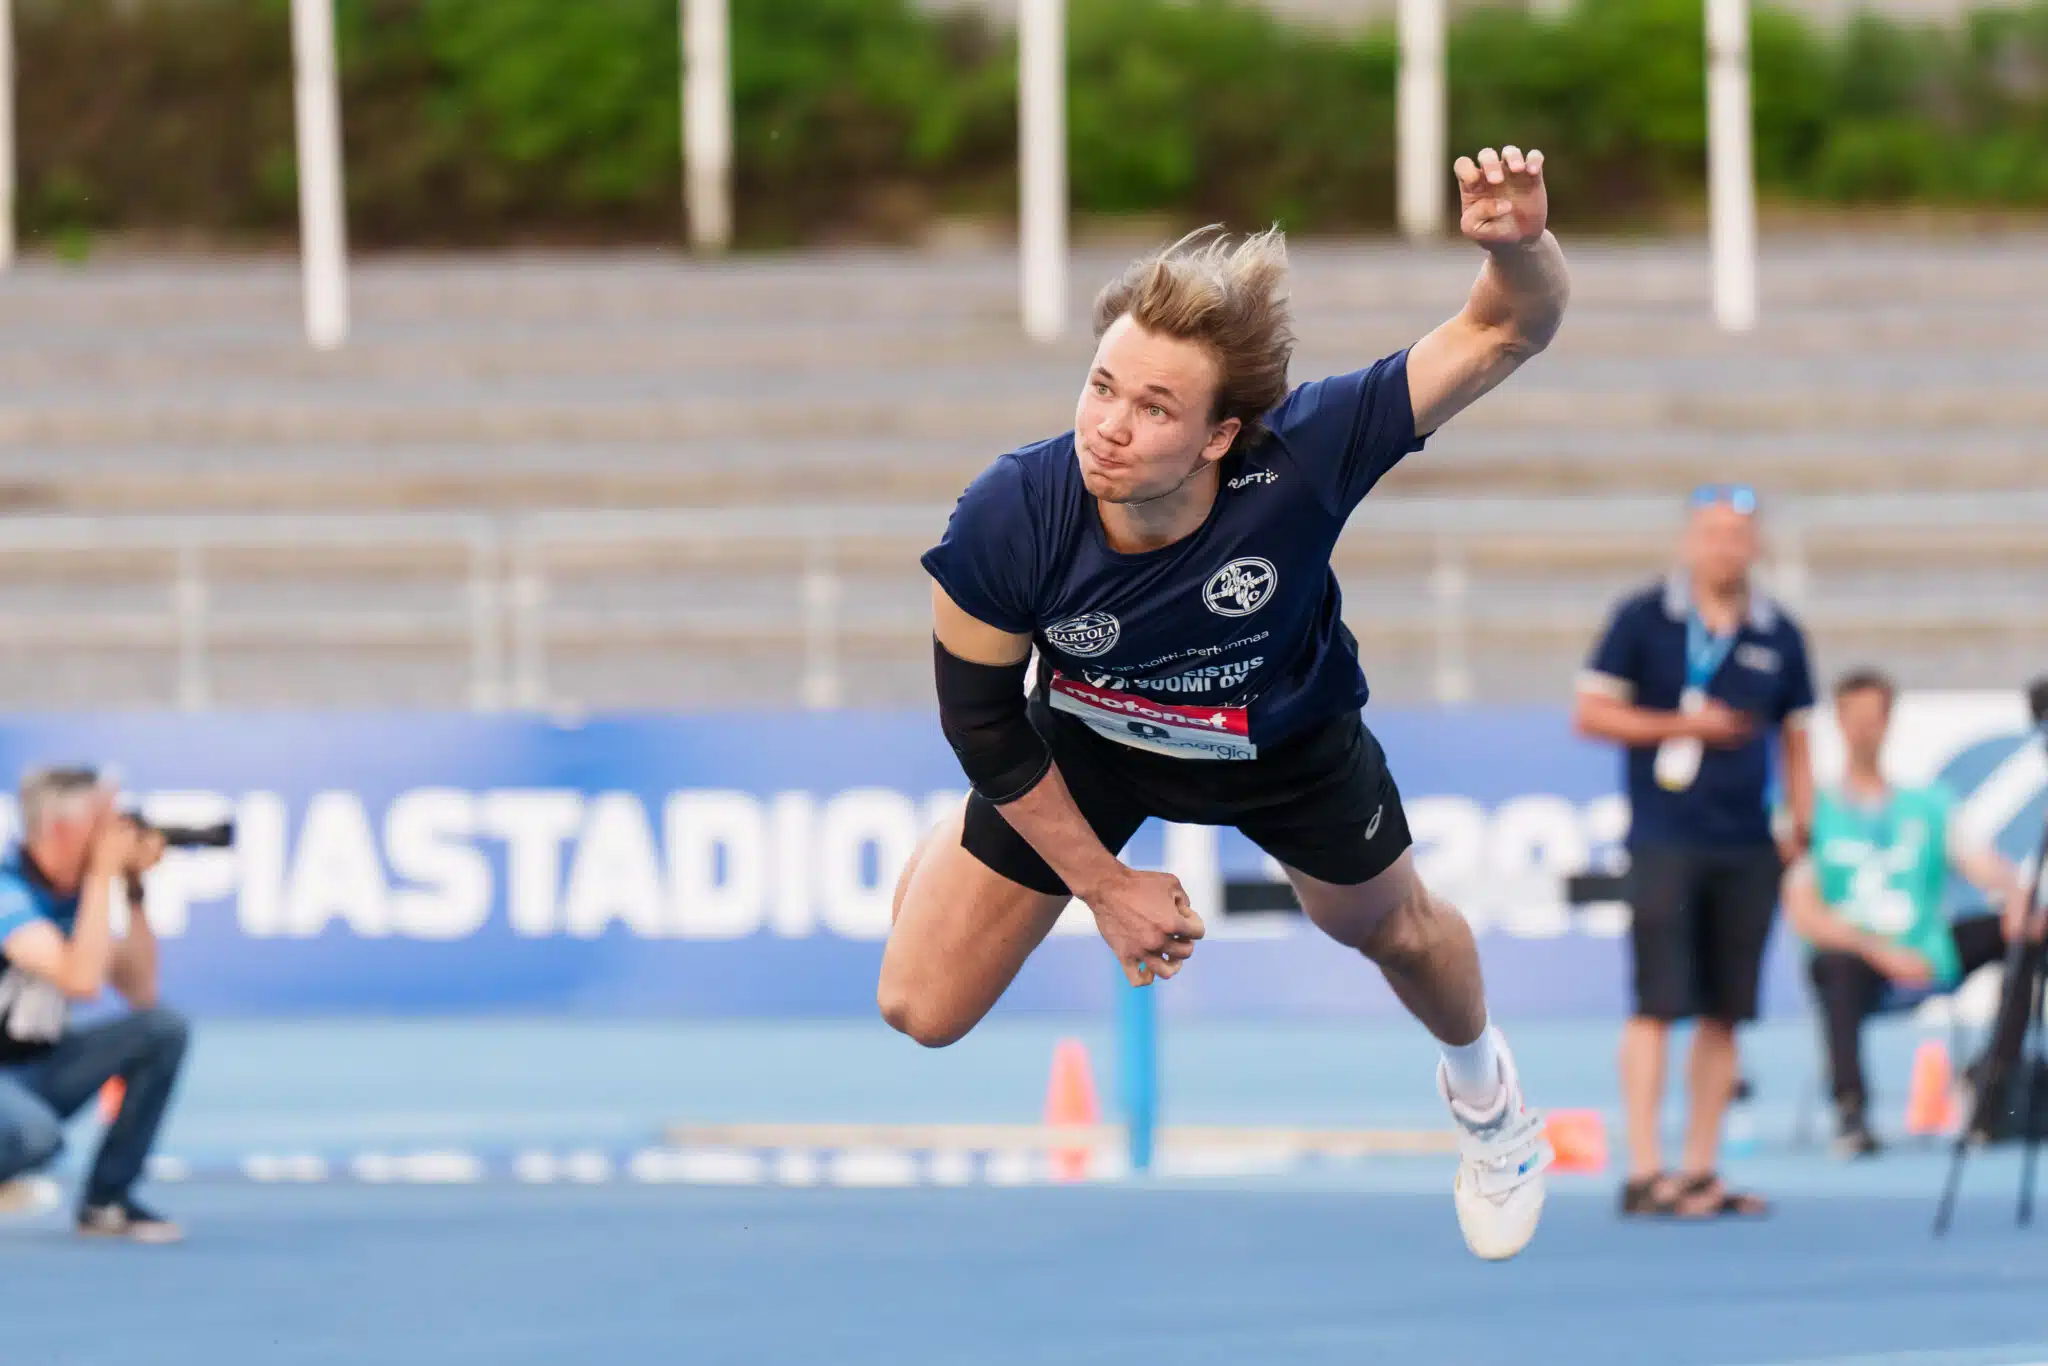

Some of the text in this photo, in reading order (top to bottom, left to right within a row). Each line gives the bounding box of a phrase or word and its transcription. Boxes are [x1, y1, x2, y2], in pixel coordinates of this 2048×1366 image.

[1227, 472, 1265, 489] RAFT
[1219, 673, 1248, 689] OY
[1064, 686, 1228, 731] motonet
[70, 786, 970, 941] PIASTADIO
